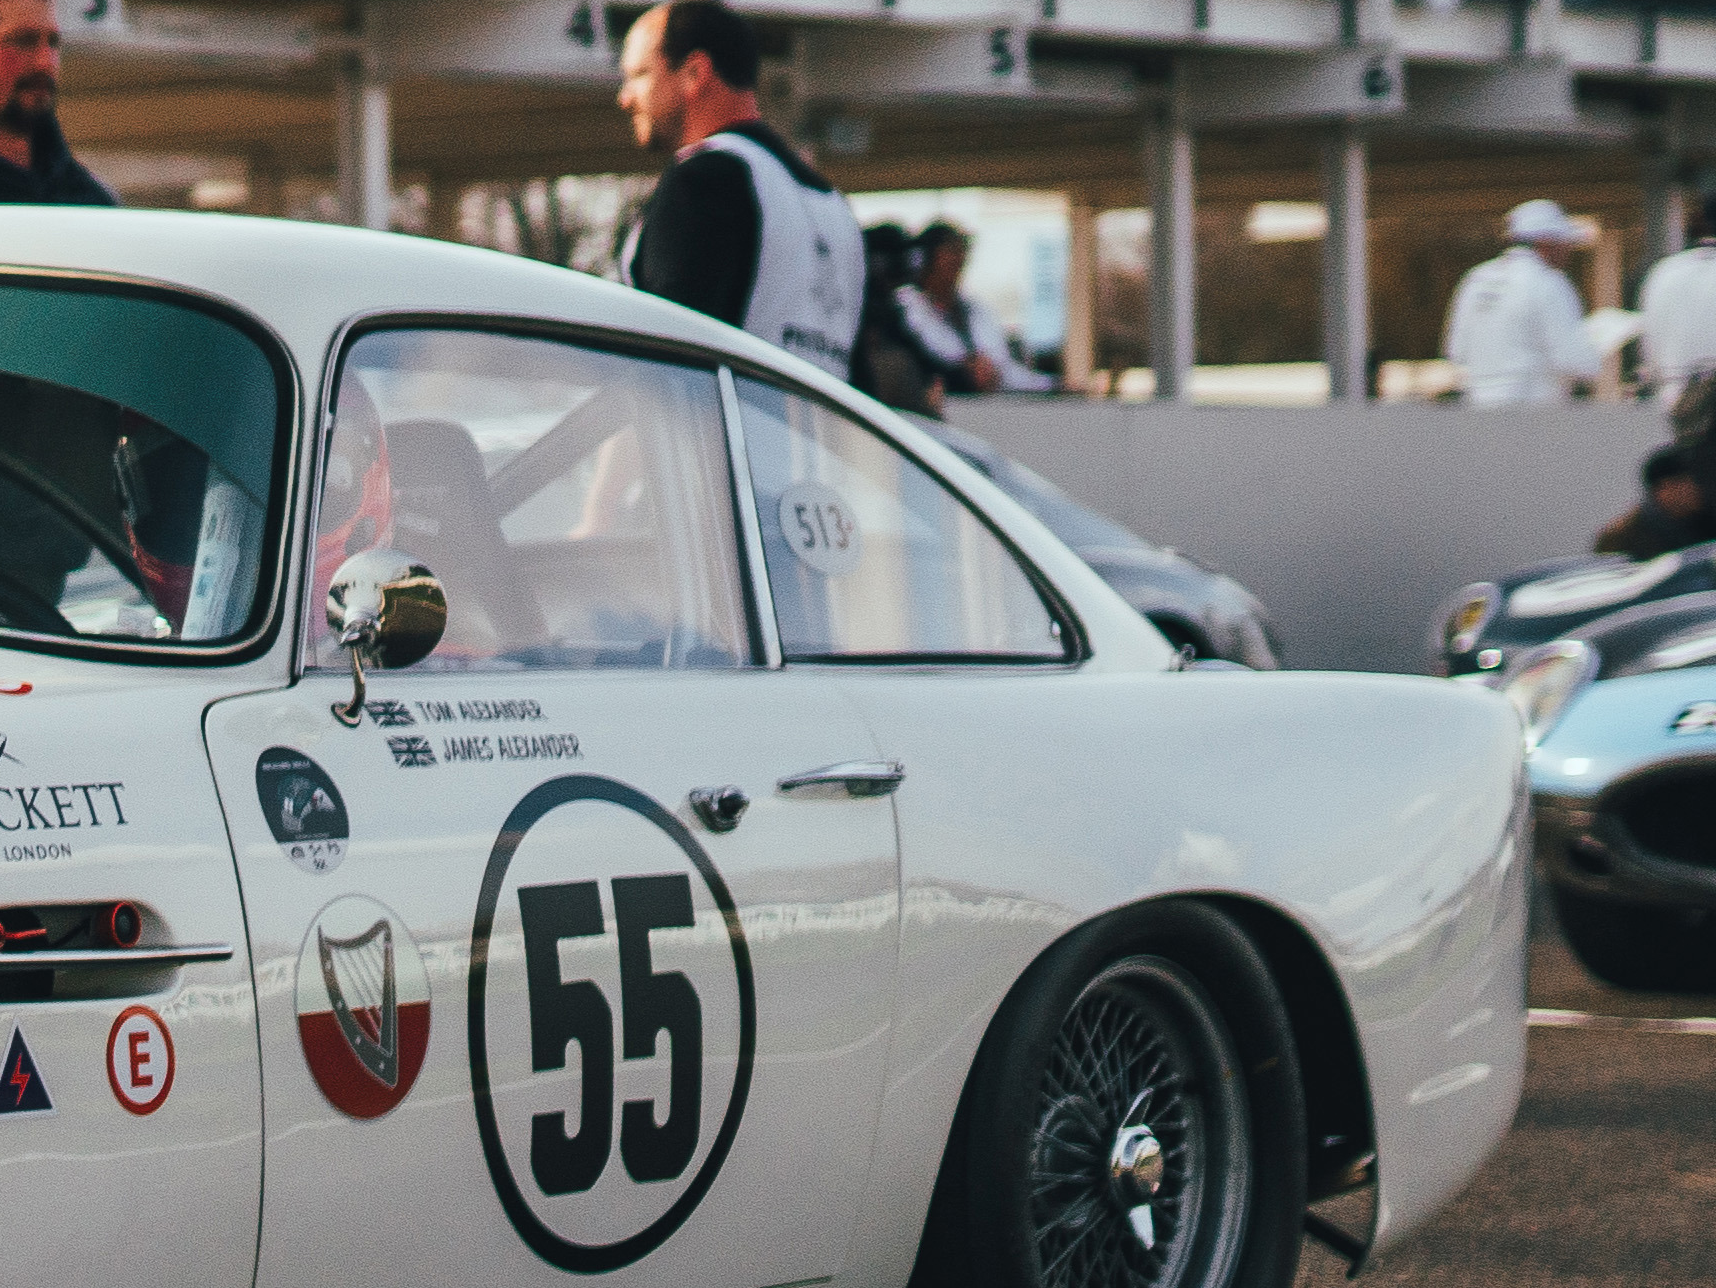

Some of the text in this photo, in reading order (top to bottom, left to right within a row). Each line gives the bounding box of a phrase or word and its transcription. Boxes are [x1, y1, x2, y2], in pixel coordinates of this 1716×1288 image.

[990, 27, 1015, 76] 5
[794, 502, 849, 550] 513
[414, 698, 547, 723] TOM ALEXANDER
[442, 732, 583, 762] JAMES ALEXANDER
[4, 843, 72, 862] LONDON
[518, 872, 702, 1197] 55
[128, 1030, 153, 1088] E
